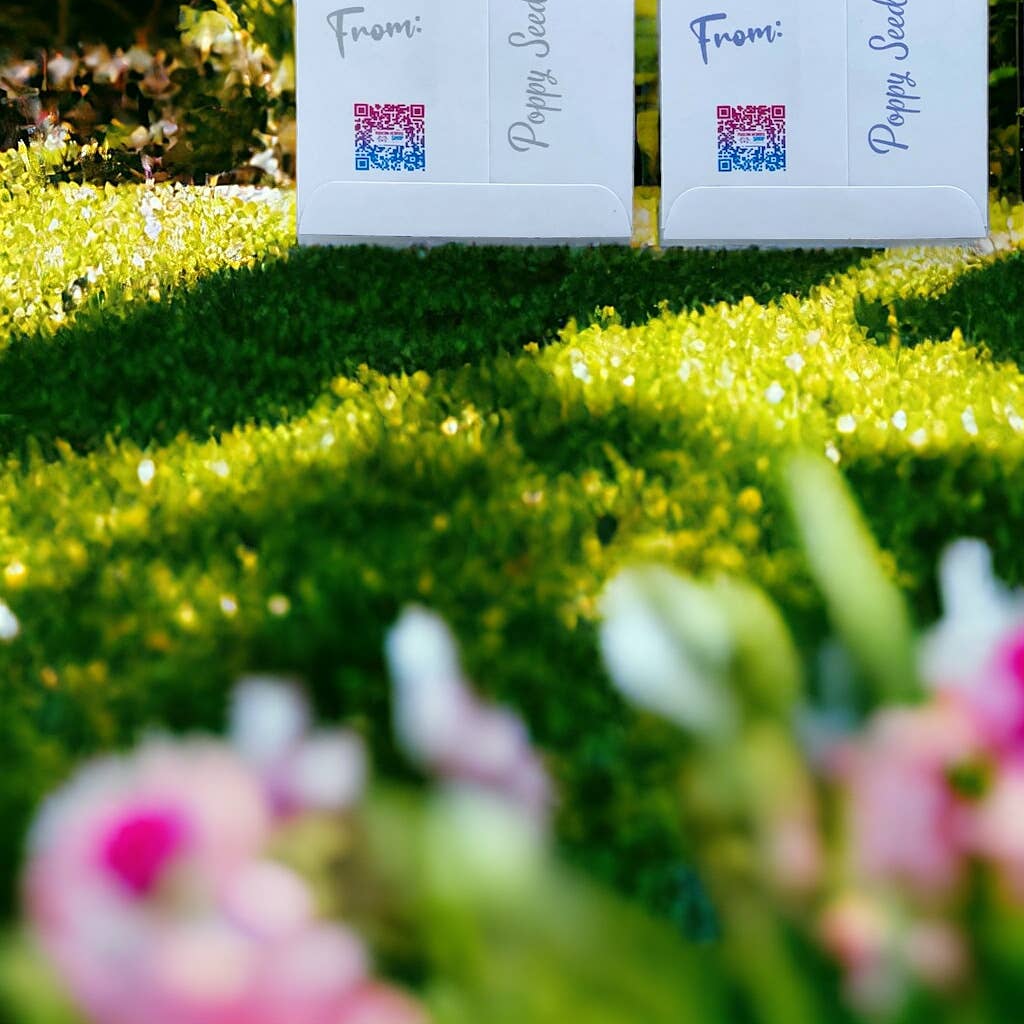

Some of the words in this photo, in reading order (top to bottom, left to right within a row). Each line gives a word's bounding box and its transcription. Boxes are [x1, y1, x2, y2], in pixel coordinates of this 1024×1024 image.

[326, 6, 423, 59] From:
[689, 12, 784, 66] From:
[507, 68, 565, 153] Poppy
[867, 71, 922, 155] Poppy
